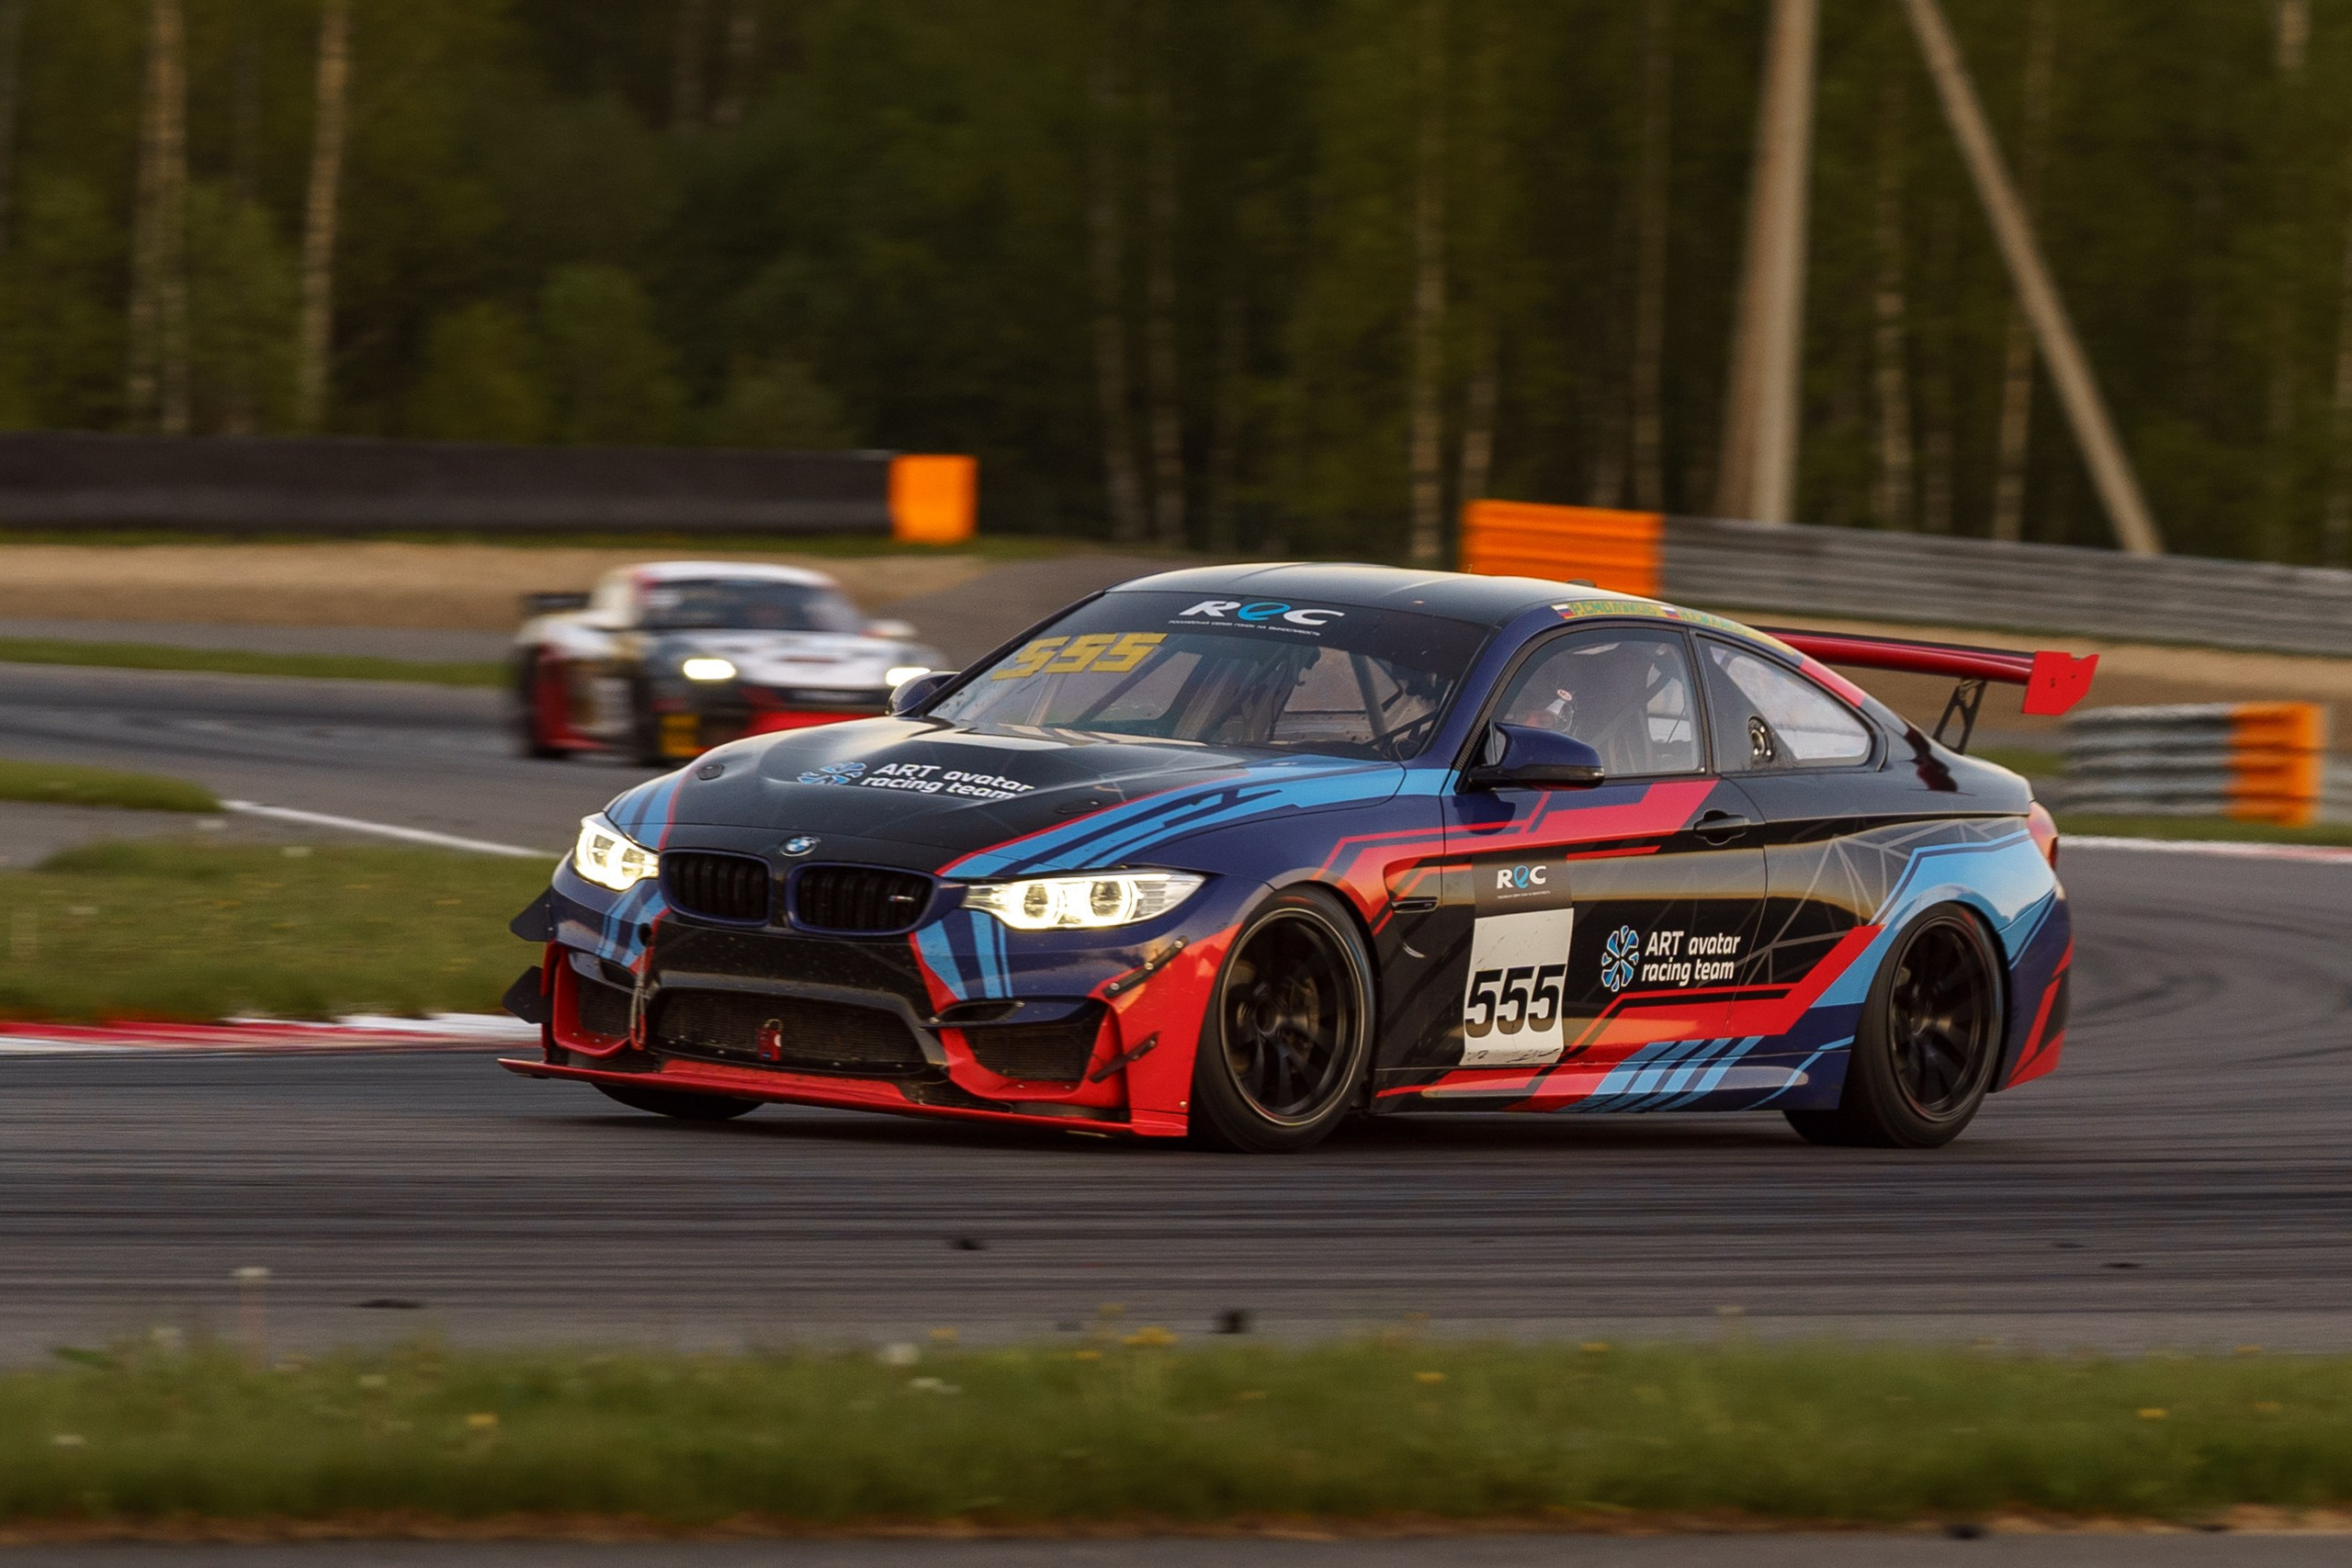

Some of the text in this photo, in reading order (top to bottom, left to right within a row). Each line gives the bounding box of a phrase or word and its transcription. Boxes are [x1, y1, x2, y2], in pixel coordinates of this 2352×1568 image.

[989, 632, 1168, 682] 555
[860, 775, 1018, 800] racing team
[872, 762, 1035, 794] ART avatar
[1645, 931, 1741, 956] ART avatar
[1641, 960, 1736, 987] racing team
[1464, 963, 1566, 1038] 555
